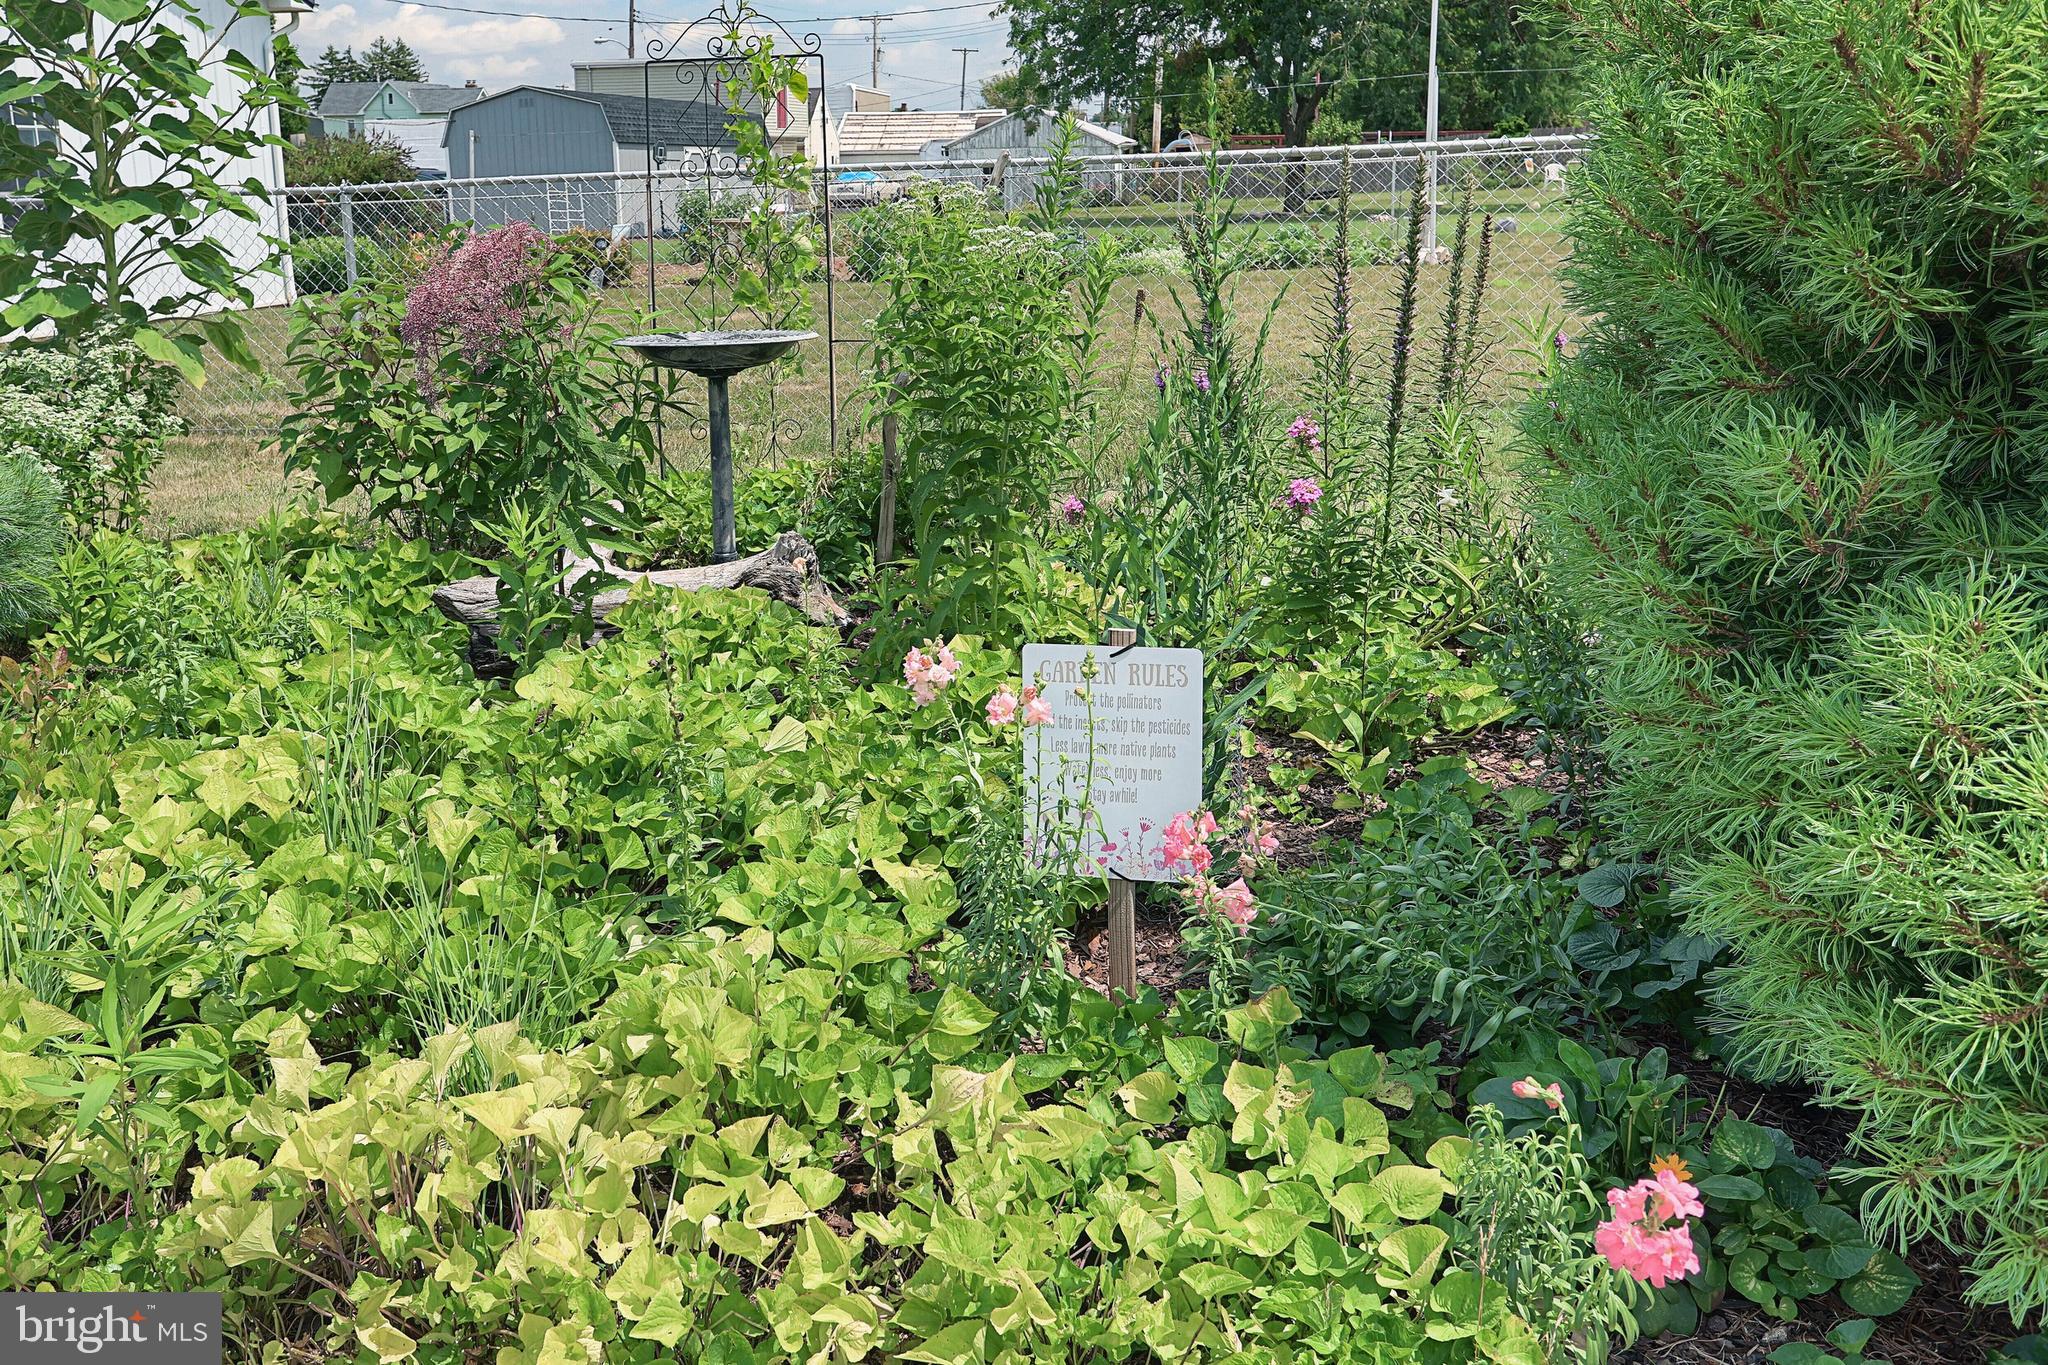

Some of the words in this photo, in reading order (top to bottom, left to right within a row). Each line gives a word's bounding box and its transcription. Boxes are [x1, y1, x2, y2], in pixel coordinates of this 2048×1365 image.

[1040, 660, 1116, 685] GAREN
[1128, 663, 1189, 687] RULES
[1100, 692, 1114, 708] the
[1117, 692, 1162, 711] pollinators
[1059, 714, 1073, 730] the
[1111, 716, 1128, 735] skip
[1132, 717, 1146, 733] the
[1149, 718, 1191, 736] pesticides
[1051, 736, 1068, 753] Less
[1096, 742, 1117, 756] more
[1120, 739, 1147, 757] native
[1150, 741, 1177, 760] plants
[1065, 761, 1092, 777] Wate
[1114, 764, 1138, 784] enjoy
[1140, 768, 1162, 782] more
[1109, 787, 1138, 804] awhile!
